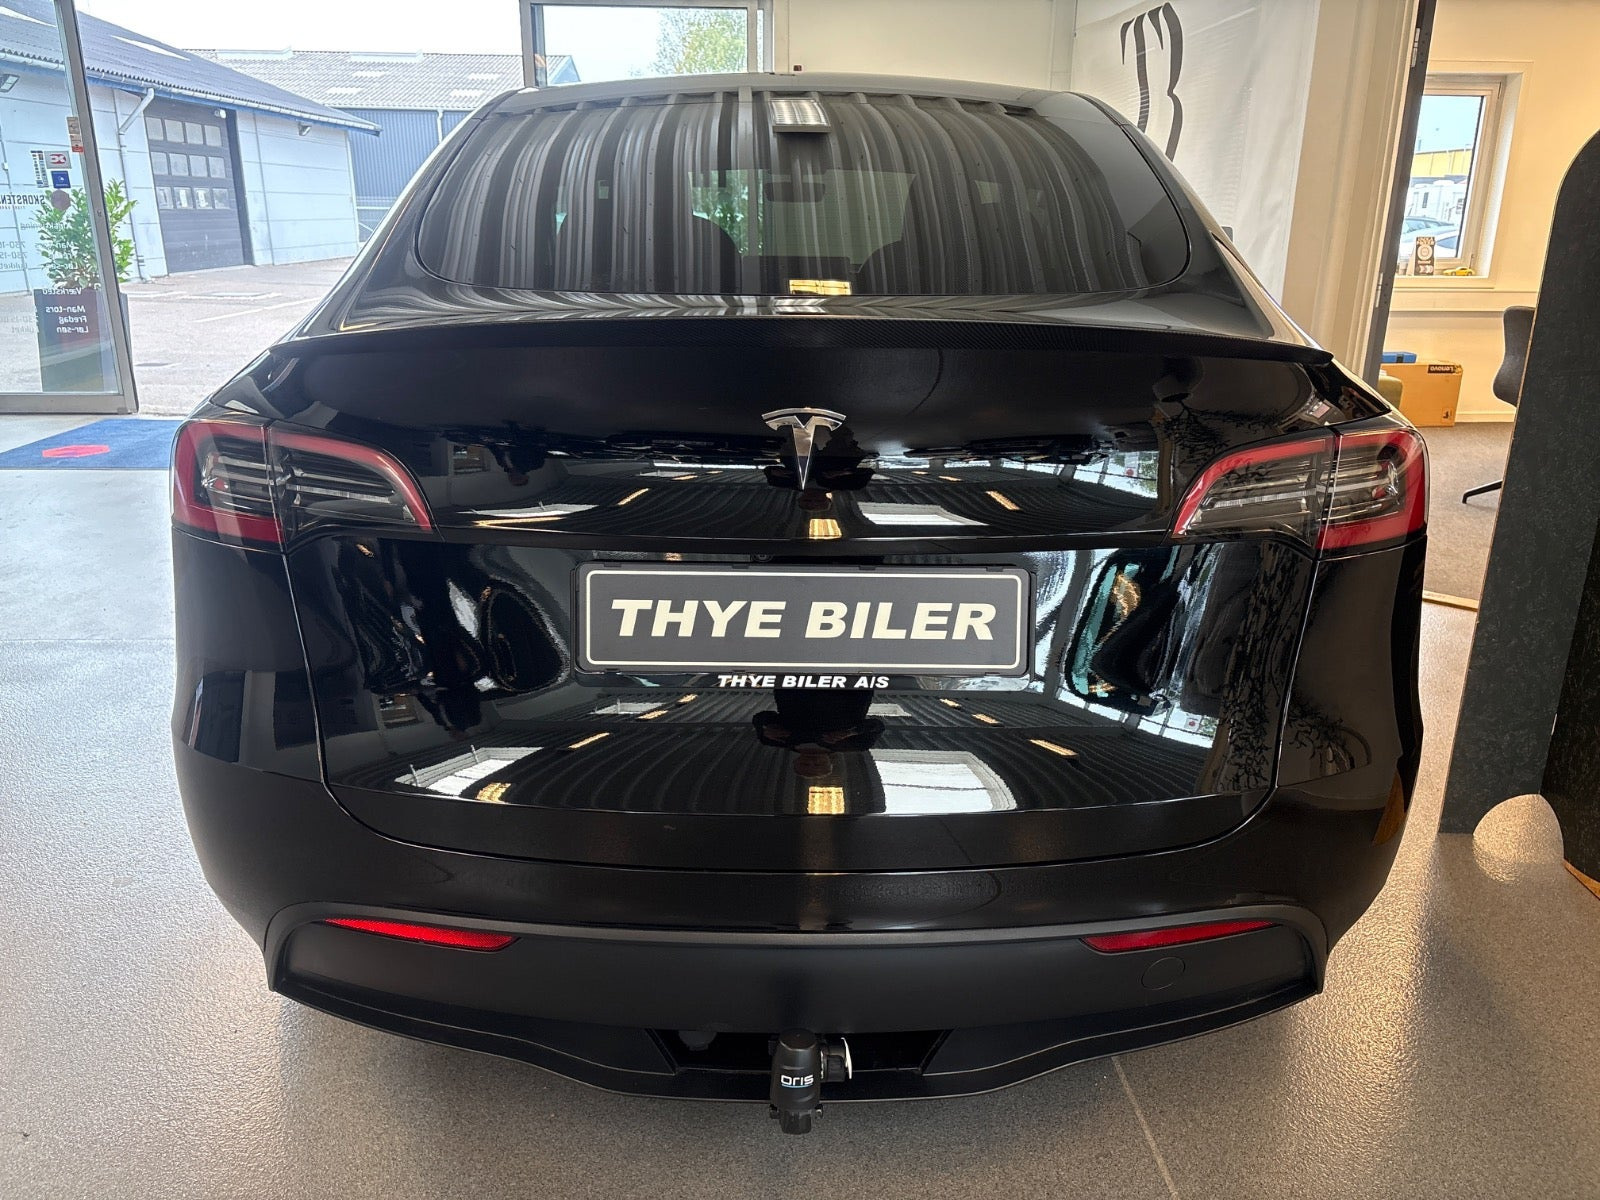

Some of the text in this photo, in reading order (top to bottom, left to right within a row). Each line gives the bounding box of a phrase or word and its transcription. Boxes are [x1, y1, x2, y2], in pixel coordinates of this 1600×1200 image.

[611, 599, 997, 640] THYE BILER
[717, 675, 890, 688] THYE BILER A/S
